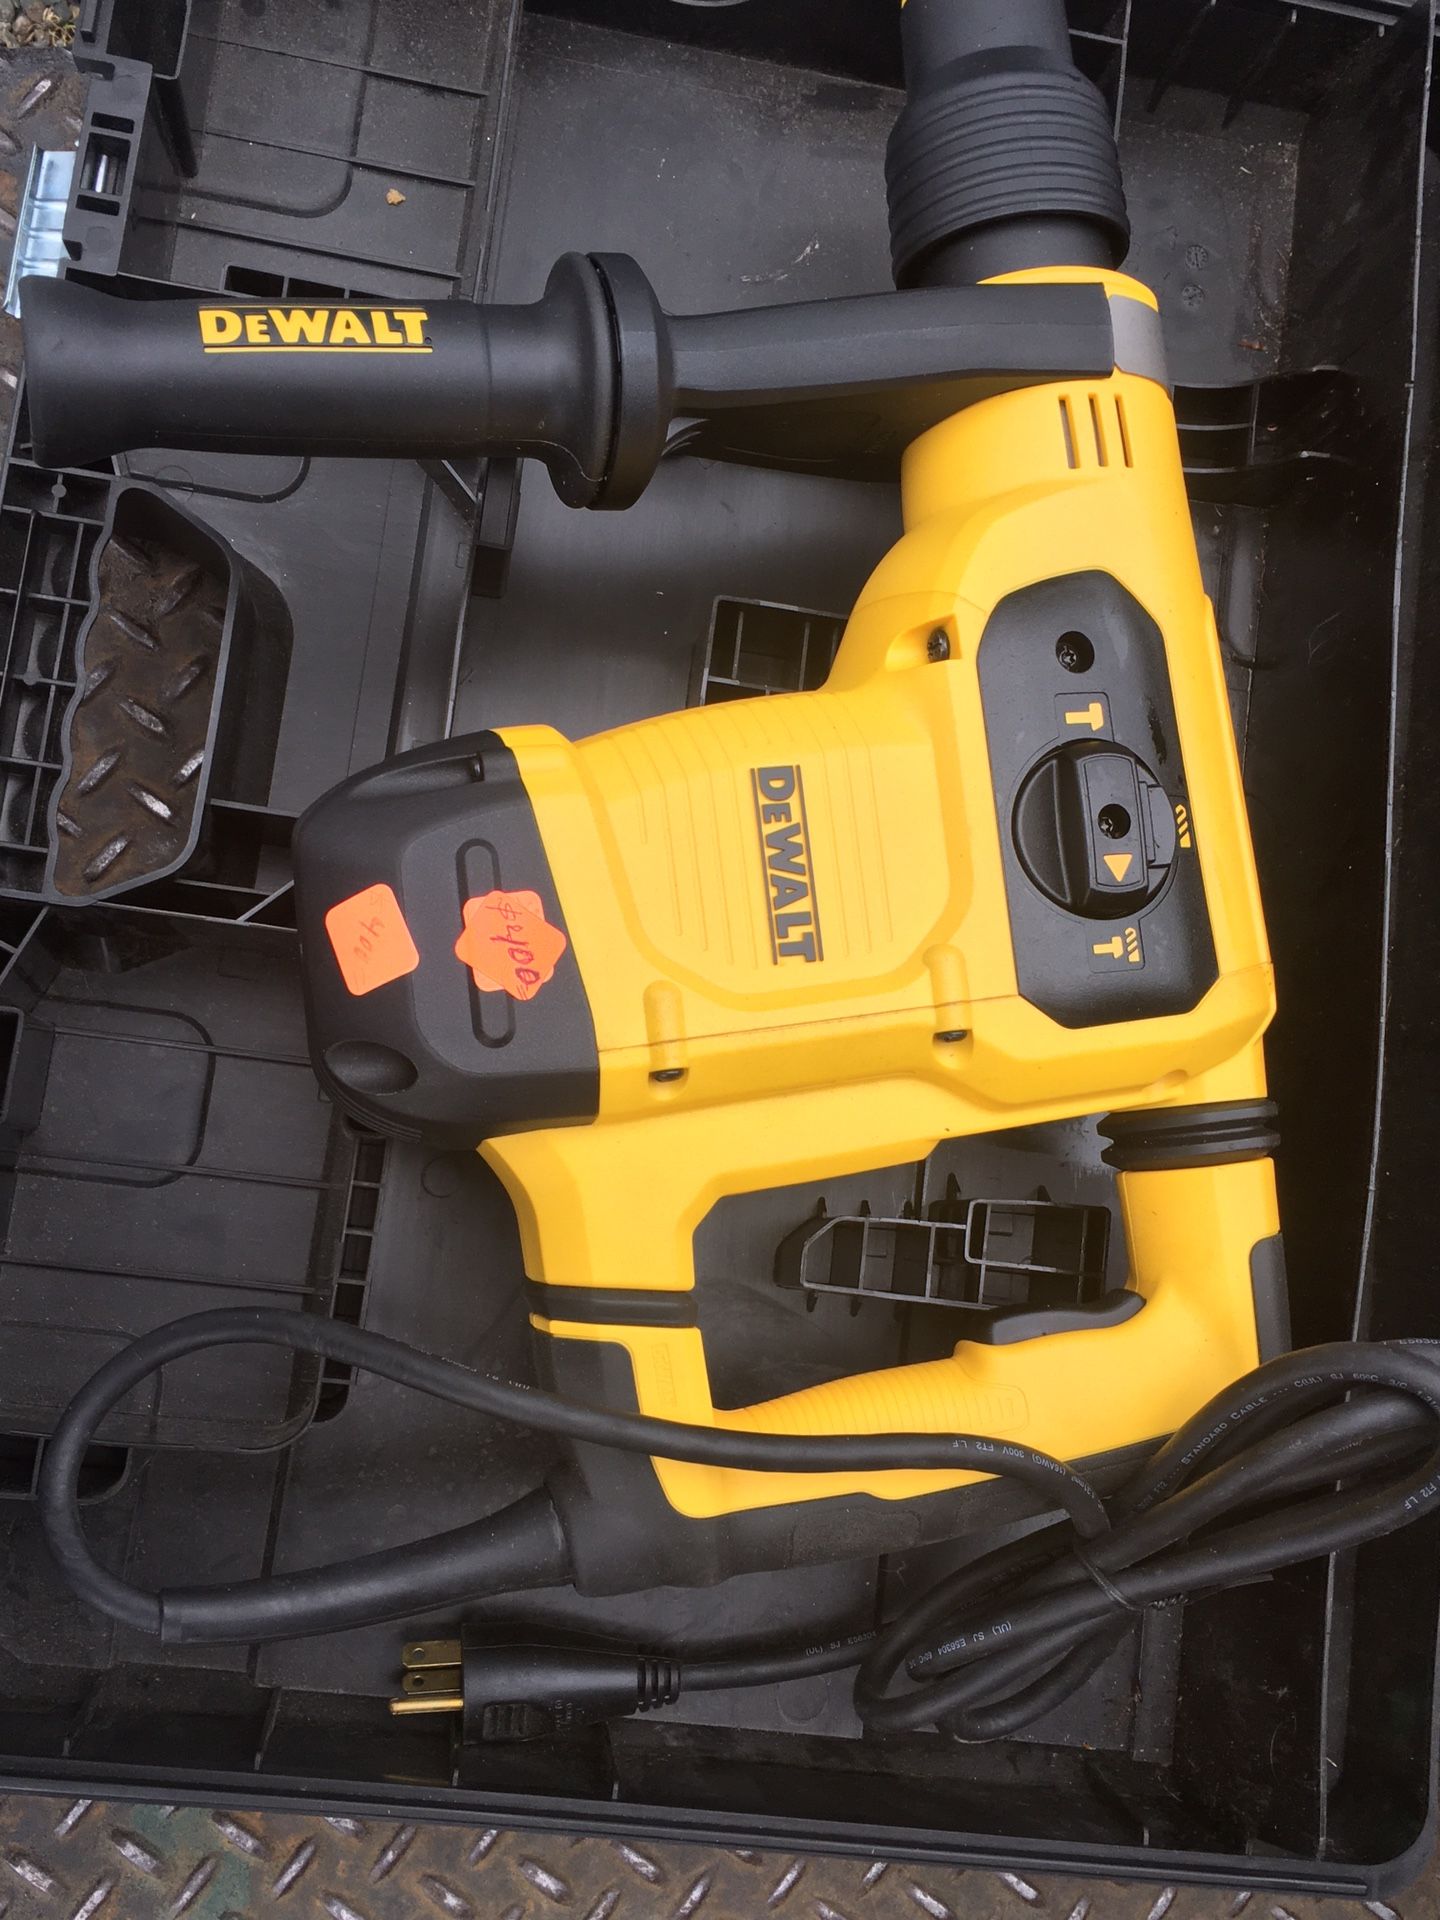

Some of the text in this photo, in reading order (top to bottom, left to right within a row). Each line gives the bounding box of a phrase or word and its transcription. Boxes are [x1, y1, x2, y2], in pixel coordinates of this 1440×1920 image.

[975, 1441, 995, 1453] FT2
[1002, 1445, 1026, 1458] 300V
[991, 1621, 1012, 1636] (UL)
[972, 1631, 985, 1642] SJ
